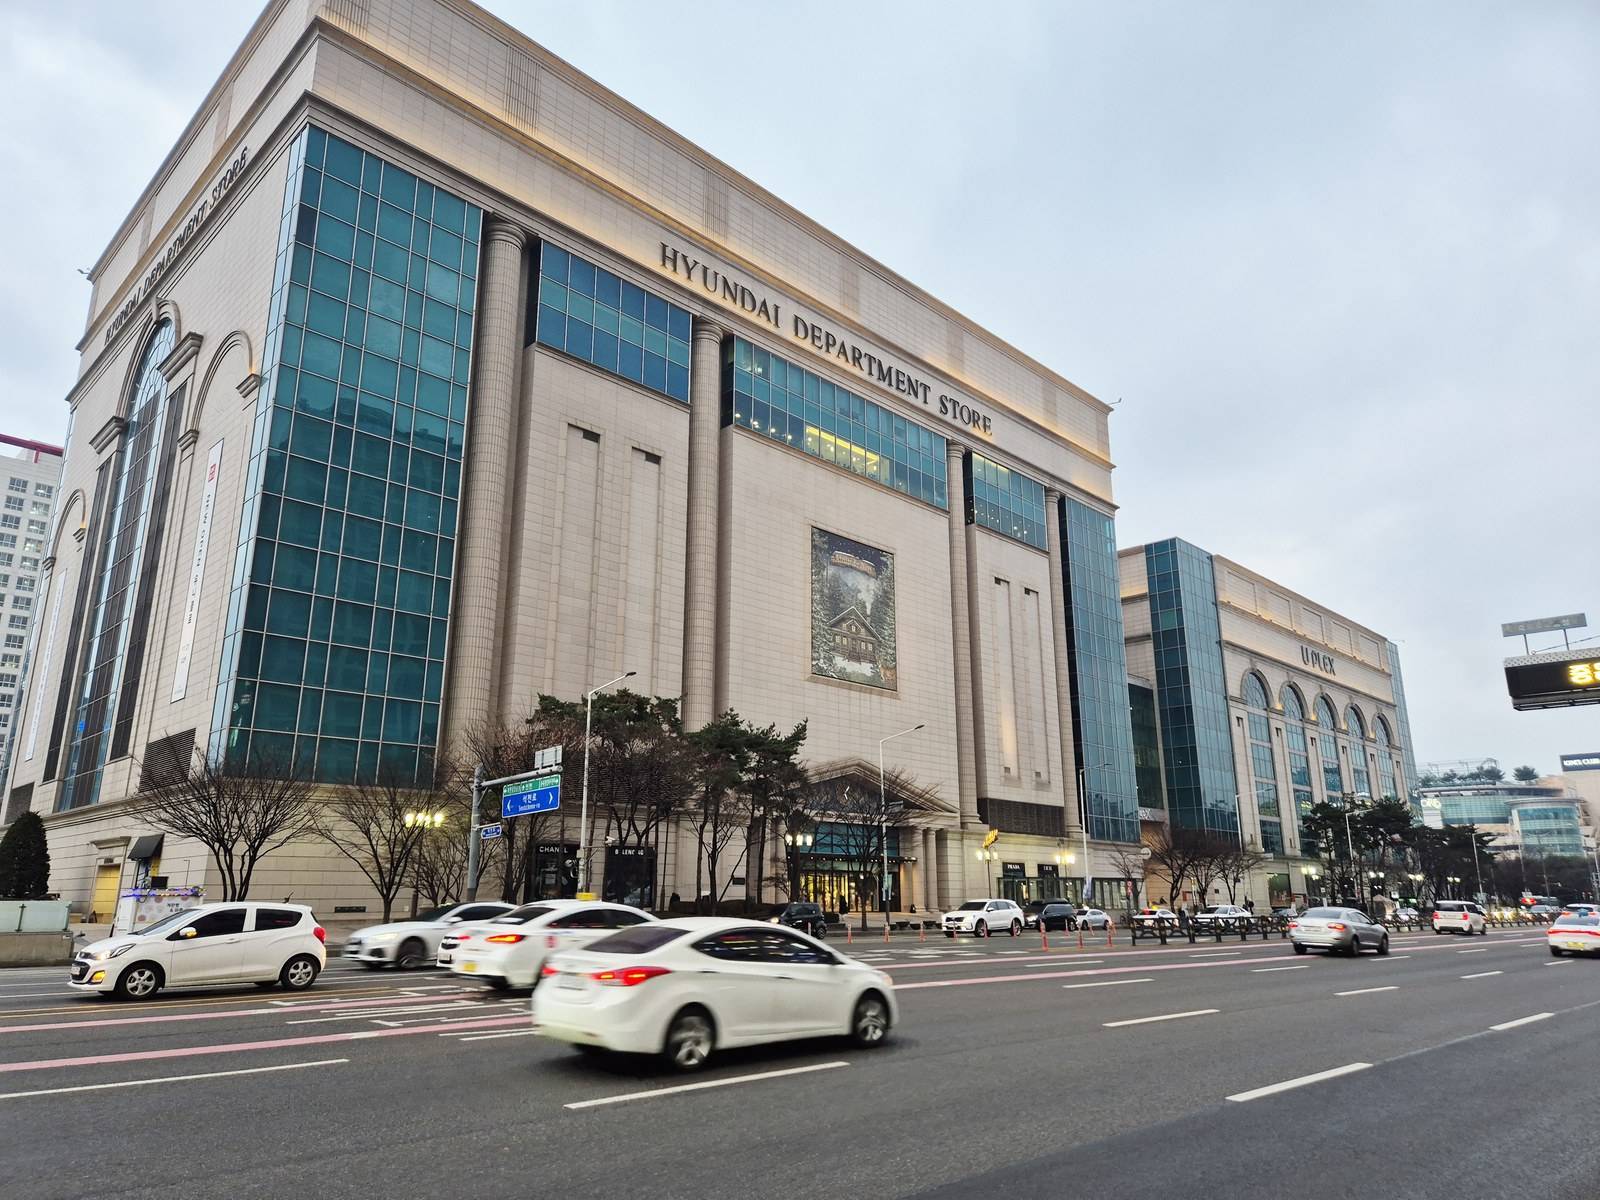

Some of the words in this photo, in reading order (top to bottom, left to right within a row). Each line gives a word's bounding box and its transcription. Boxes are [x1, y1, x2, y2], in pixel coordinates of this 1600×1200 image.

[209, 146, 248, 210] STORE
[659, 242, 781, 329] HYUNDAI
[793, 314, 931, 405] DEPARTMENT
[939, 395, 993, 437] STORE
[539, 846, 569, 854] CHANL
